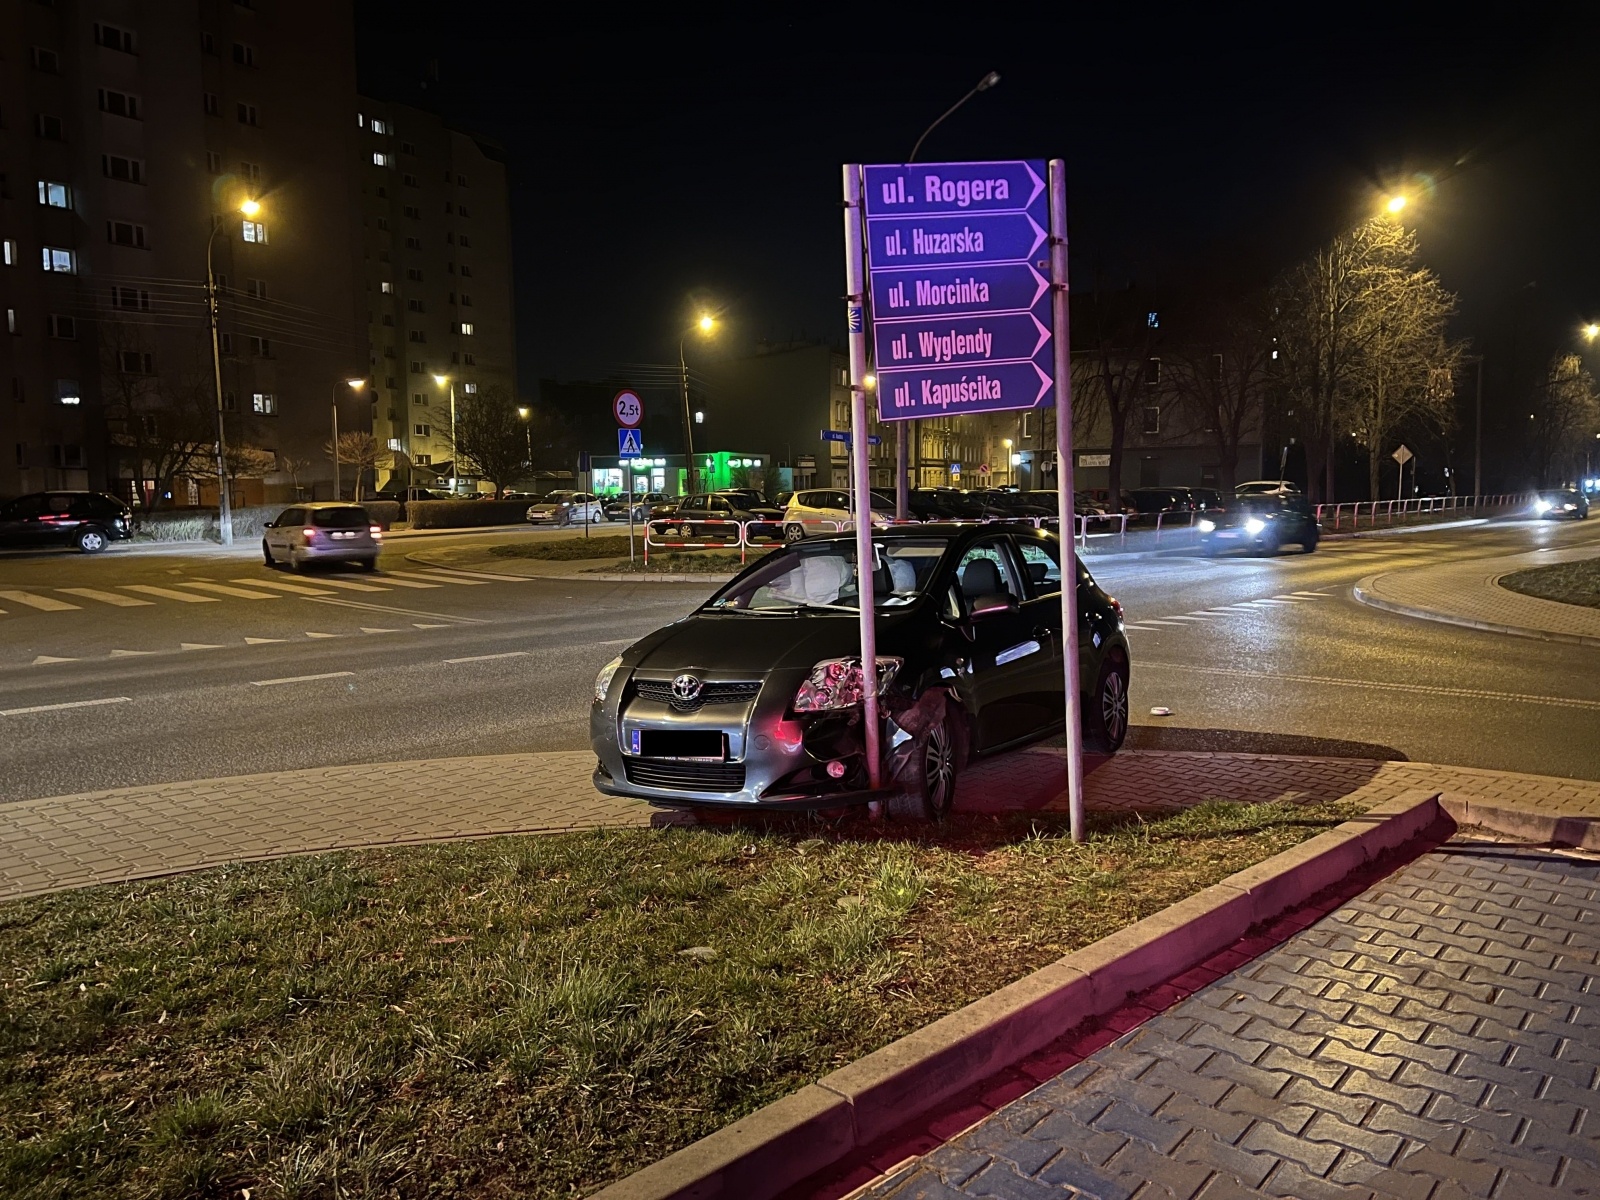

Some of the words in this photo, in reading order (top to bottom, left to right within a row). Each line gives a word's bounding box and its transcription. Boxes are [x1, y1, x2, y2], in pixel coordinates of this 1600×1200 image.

[882, 177, 915, 204] ul.
[925, 175, 1009, 207] Rogera
[885, 229, 907, 257] ul.
[913, 226, 984, 255] Huzarska
[889, 281, 910, 308] ul.
[916, 277, 989, 306] Morcinka
[892, 333, 913, 360] ul.
[918, 328, 992, 362] Wyglendy
[895, 381, 916, 408] ul.
[921, 375, 1001, 409] Kapuścika
